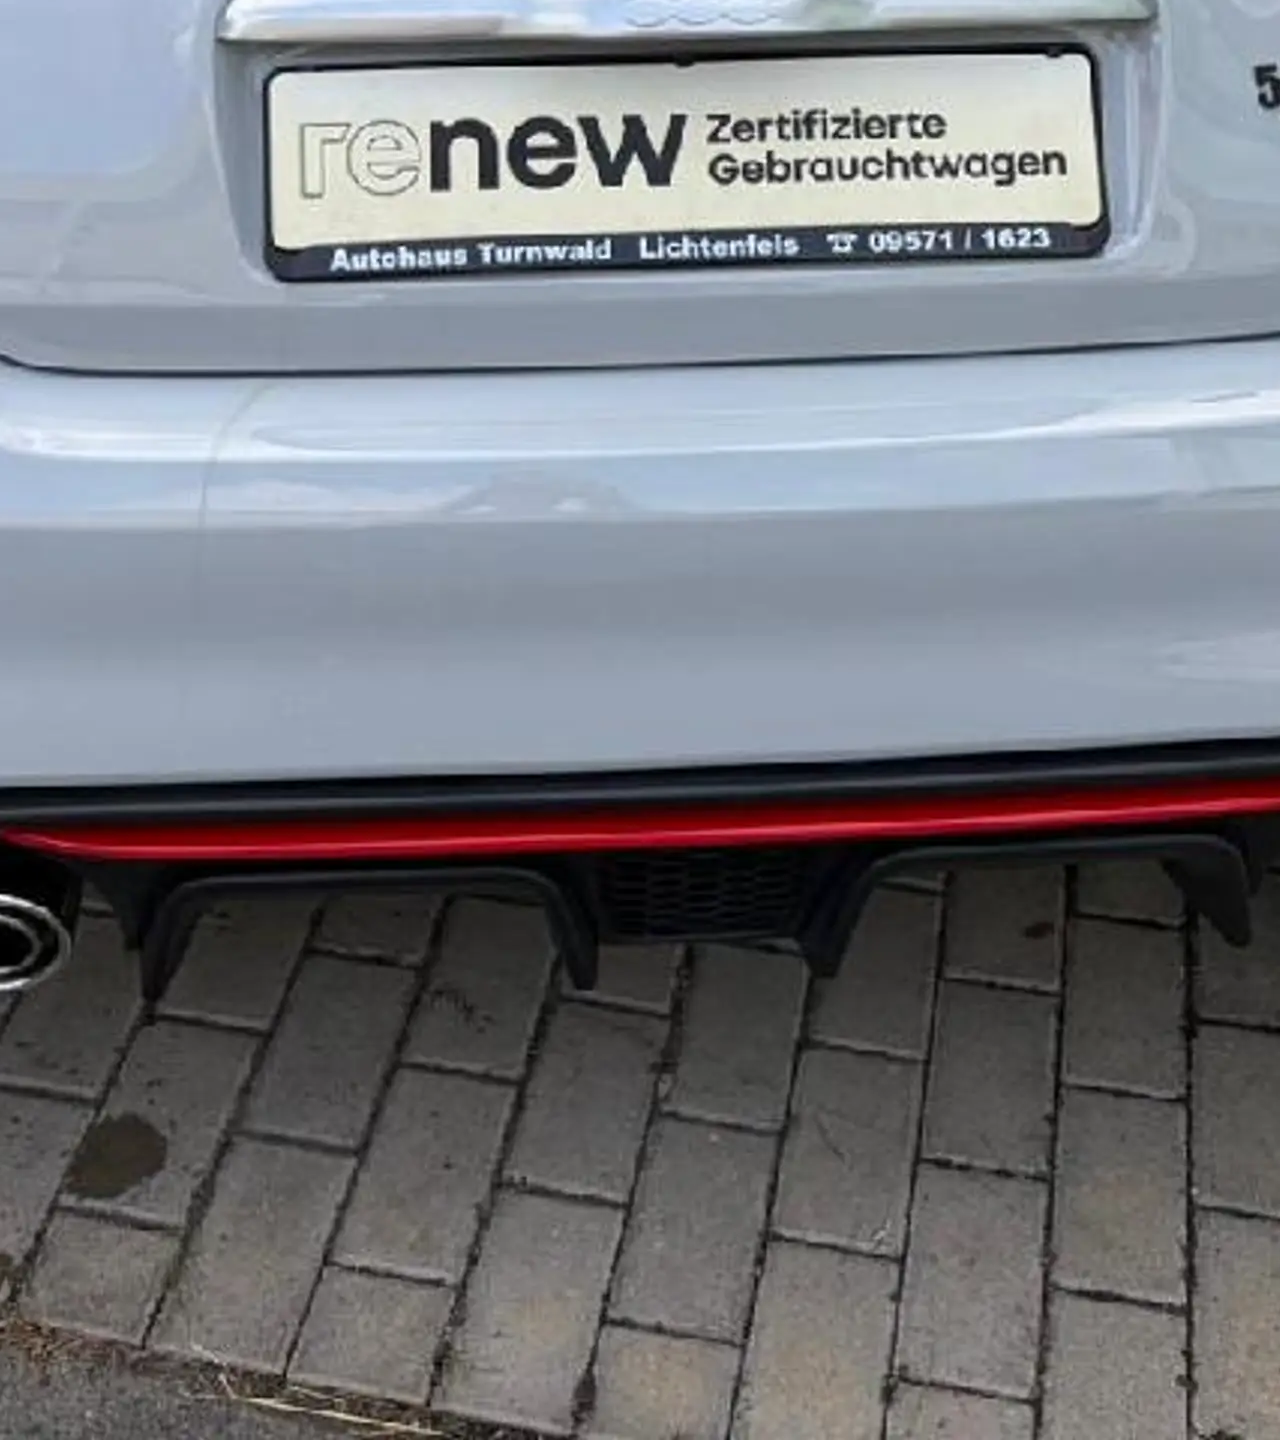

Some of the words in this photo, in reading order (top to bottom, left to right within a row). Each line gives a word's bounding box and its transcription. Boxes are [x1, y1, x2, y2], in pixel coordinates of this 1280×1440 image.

[705, 107, 948, 144] Zertifizierte
[299, 113, 689, 199] renew
[707, 147, 1068, 187] Gebrauchtwagen
[329, 245, 468, 273] Autohaus
[476, 238, 613, 265] Turnwald
[639, 234, 801, 261] Lichtenfels
[869, 229, 954, 254] 09571
[981, 227, 1052, 250] 1623
